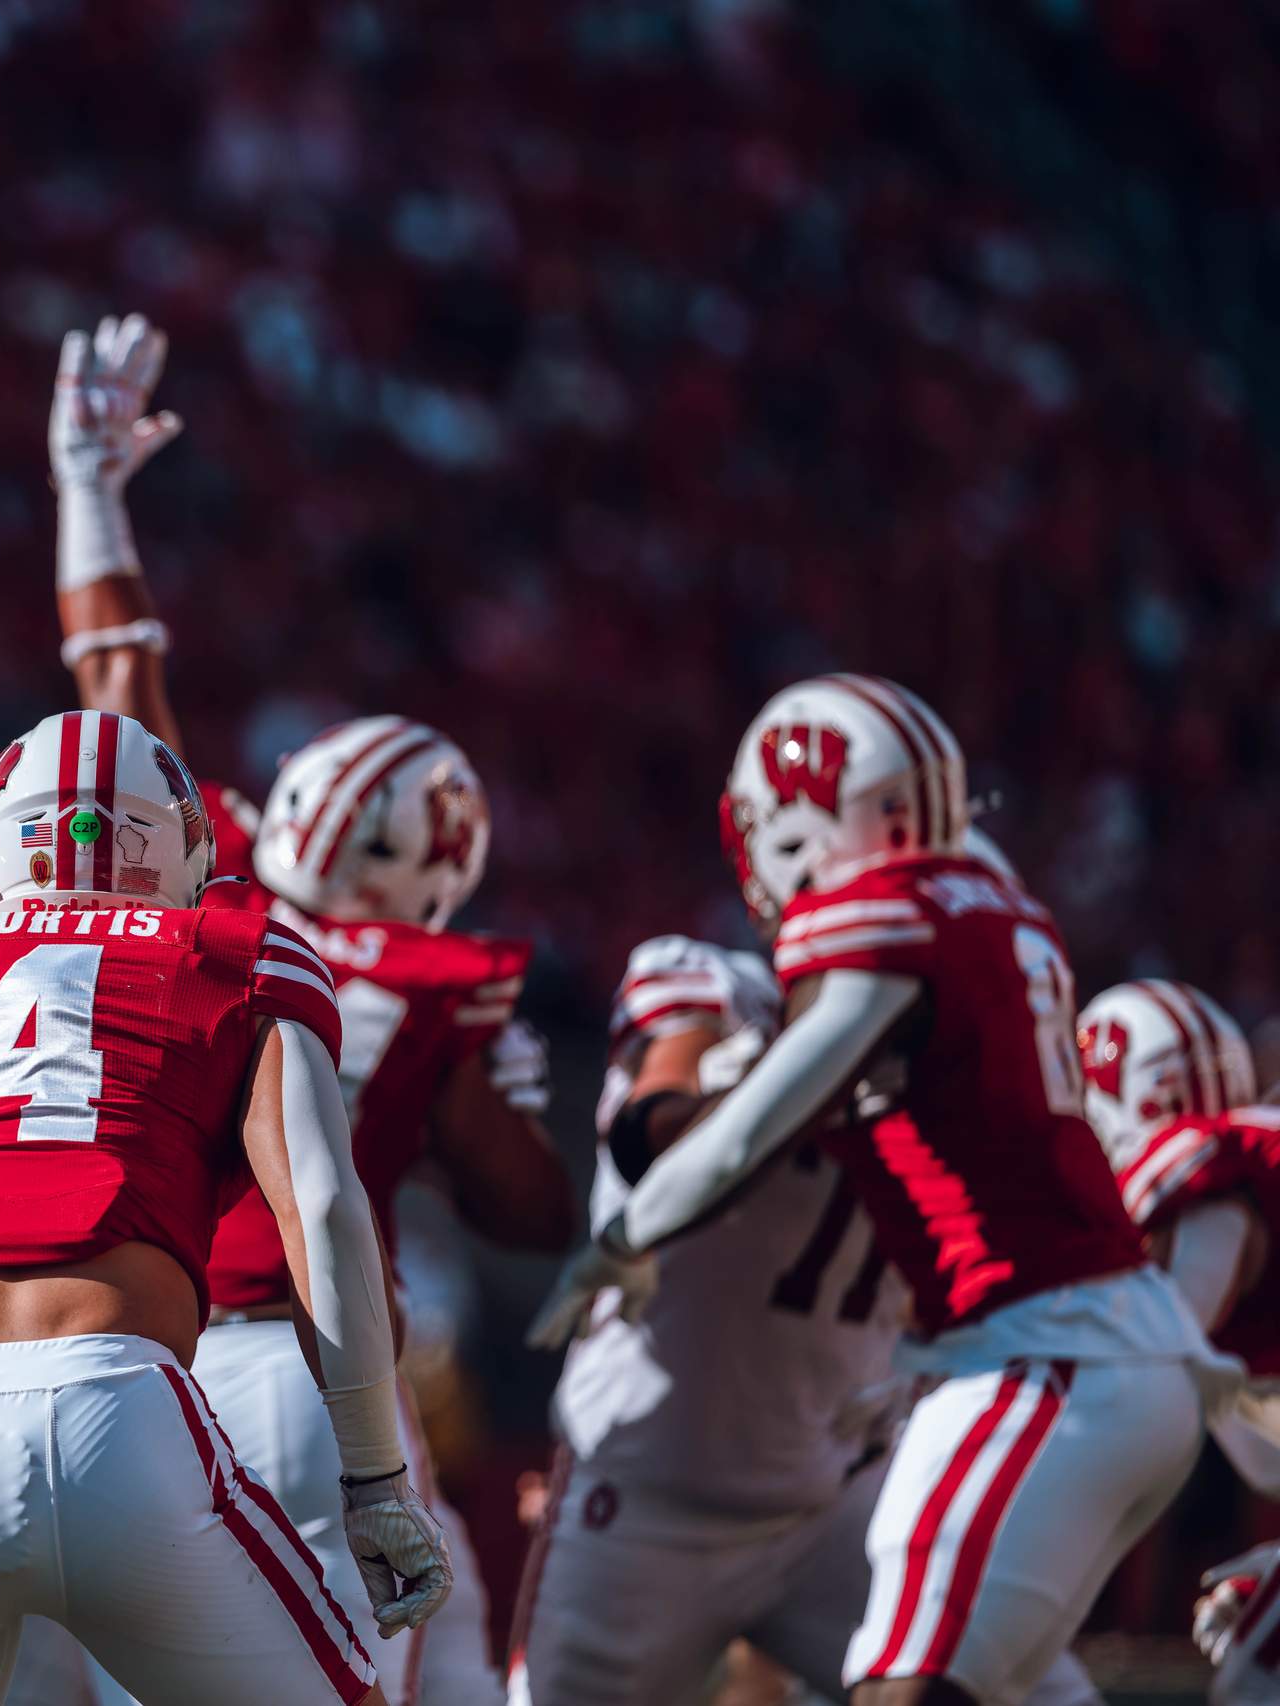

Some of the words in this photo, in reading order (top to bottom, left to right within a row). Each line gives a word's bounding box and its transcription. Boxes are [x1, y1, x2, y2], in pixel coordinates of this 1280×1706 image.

[760, 722, 848, 818] W
[72, 821, 98, 833] C2P
[22, 897, 146, 912] Ridd
